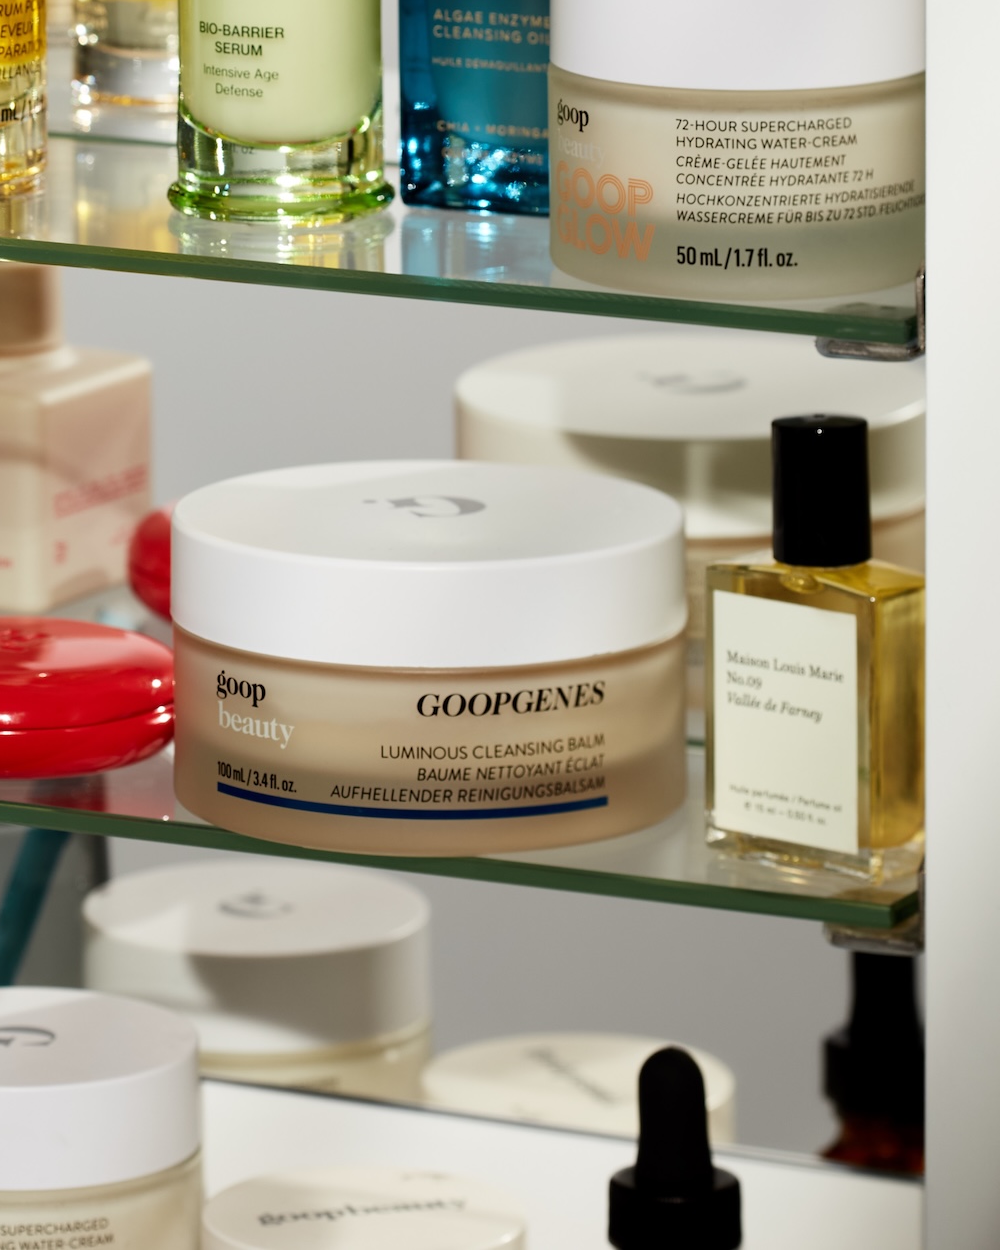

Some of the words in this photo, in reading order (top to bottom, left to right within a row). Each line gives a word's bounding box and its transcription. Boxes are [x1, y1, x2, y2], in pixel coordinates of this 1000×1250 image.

[433, 8, 483, 24] ALGAE
[199, 21, 284, 39] BIO-BARRIER
[432, 25, 523, 44] CLEANSING
[215, 41, 263, 56] SERUM
[203, 63, 250, 79] Intensive
[254, 68, 279, 83] Age
[215, 83, 263, 98] Defense
[557, 99, 590, 133] goop
[675, 118, 737, 133] 72-HOUR
[741, 116, 852, 133] SUPERCHARGED
[676, 136, 757, 150] HYDRATING
[761, 134, 858, 150] WATER-CREAM
[676, 153, 767, 171] CRÈME-GELÉE
[770, 154, 847, 170] HAUTEMENT
[556, 160, 653, 217] GOOP
[676, 172, 765, 187] CONCENTRÉE
[769, 171, 850, 187] HYDRATANTE
[556, 203, 656, 262] GLOW
[727, 650, 770, 670] Maison
[773, 658, 806, 676] Louis
[809, 664, 845, 683] Marie
[216, 670, 266, 708] goop
[416, 680, 606, 718] GOOPGENES
[218, 700, 295, 749] beauty
[381, 745, 468, 760] LUMINOUS
[472, 741, 564, 759] CLEANSING
[567, 733, 605, 751] BALM
[417, 768, 471, 782] BAUME
[476, 760, 562, 781] NETTOYANT
[565, 754, 605, 774] ÉCLAT
[330, 785, 453, 803] AUFHELLENDER
[457, 776, 606, 803] REINIGUNGSBALSAM
[0, 1217, 109, 1236] SUPERCHARGED
